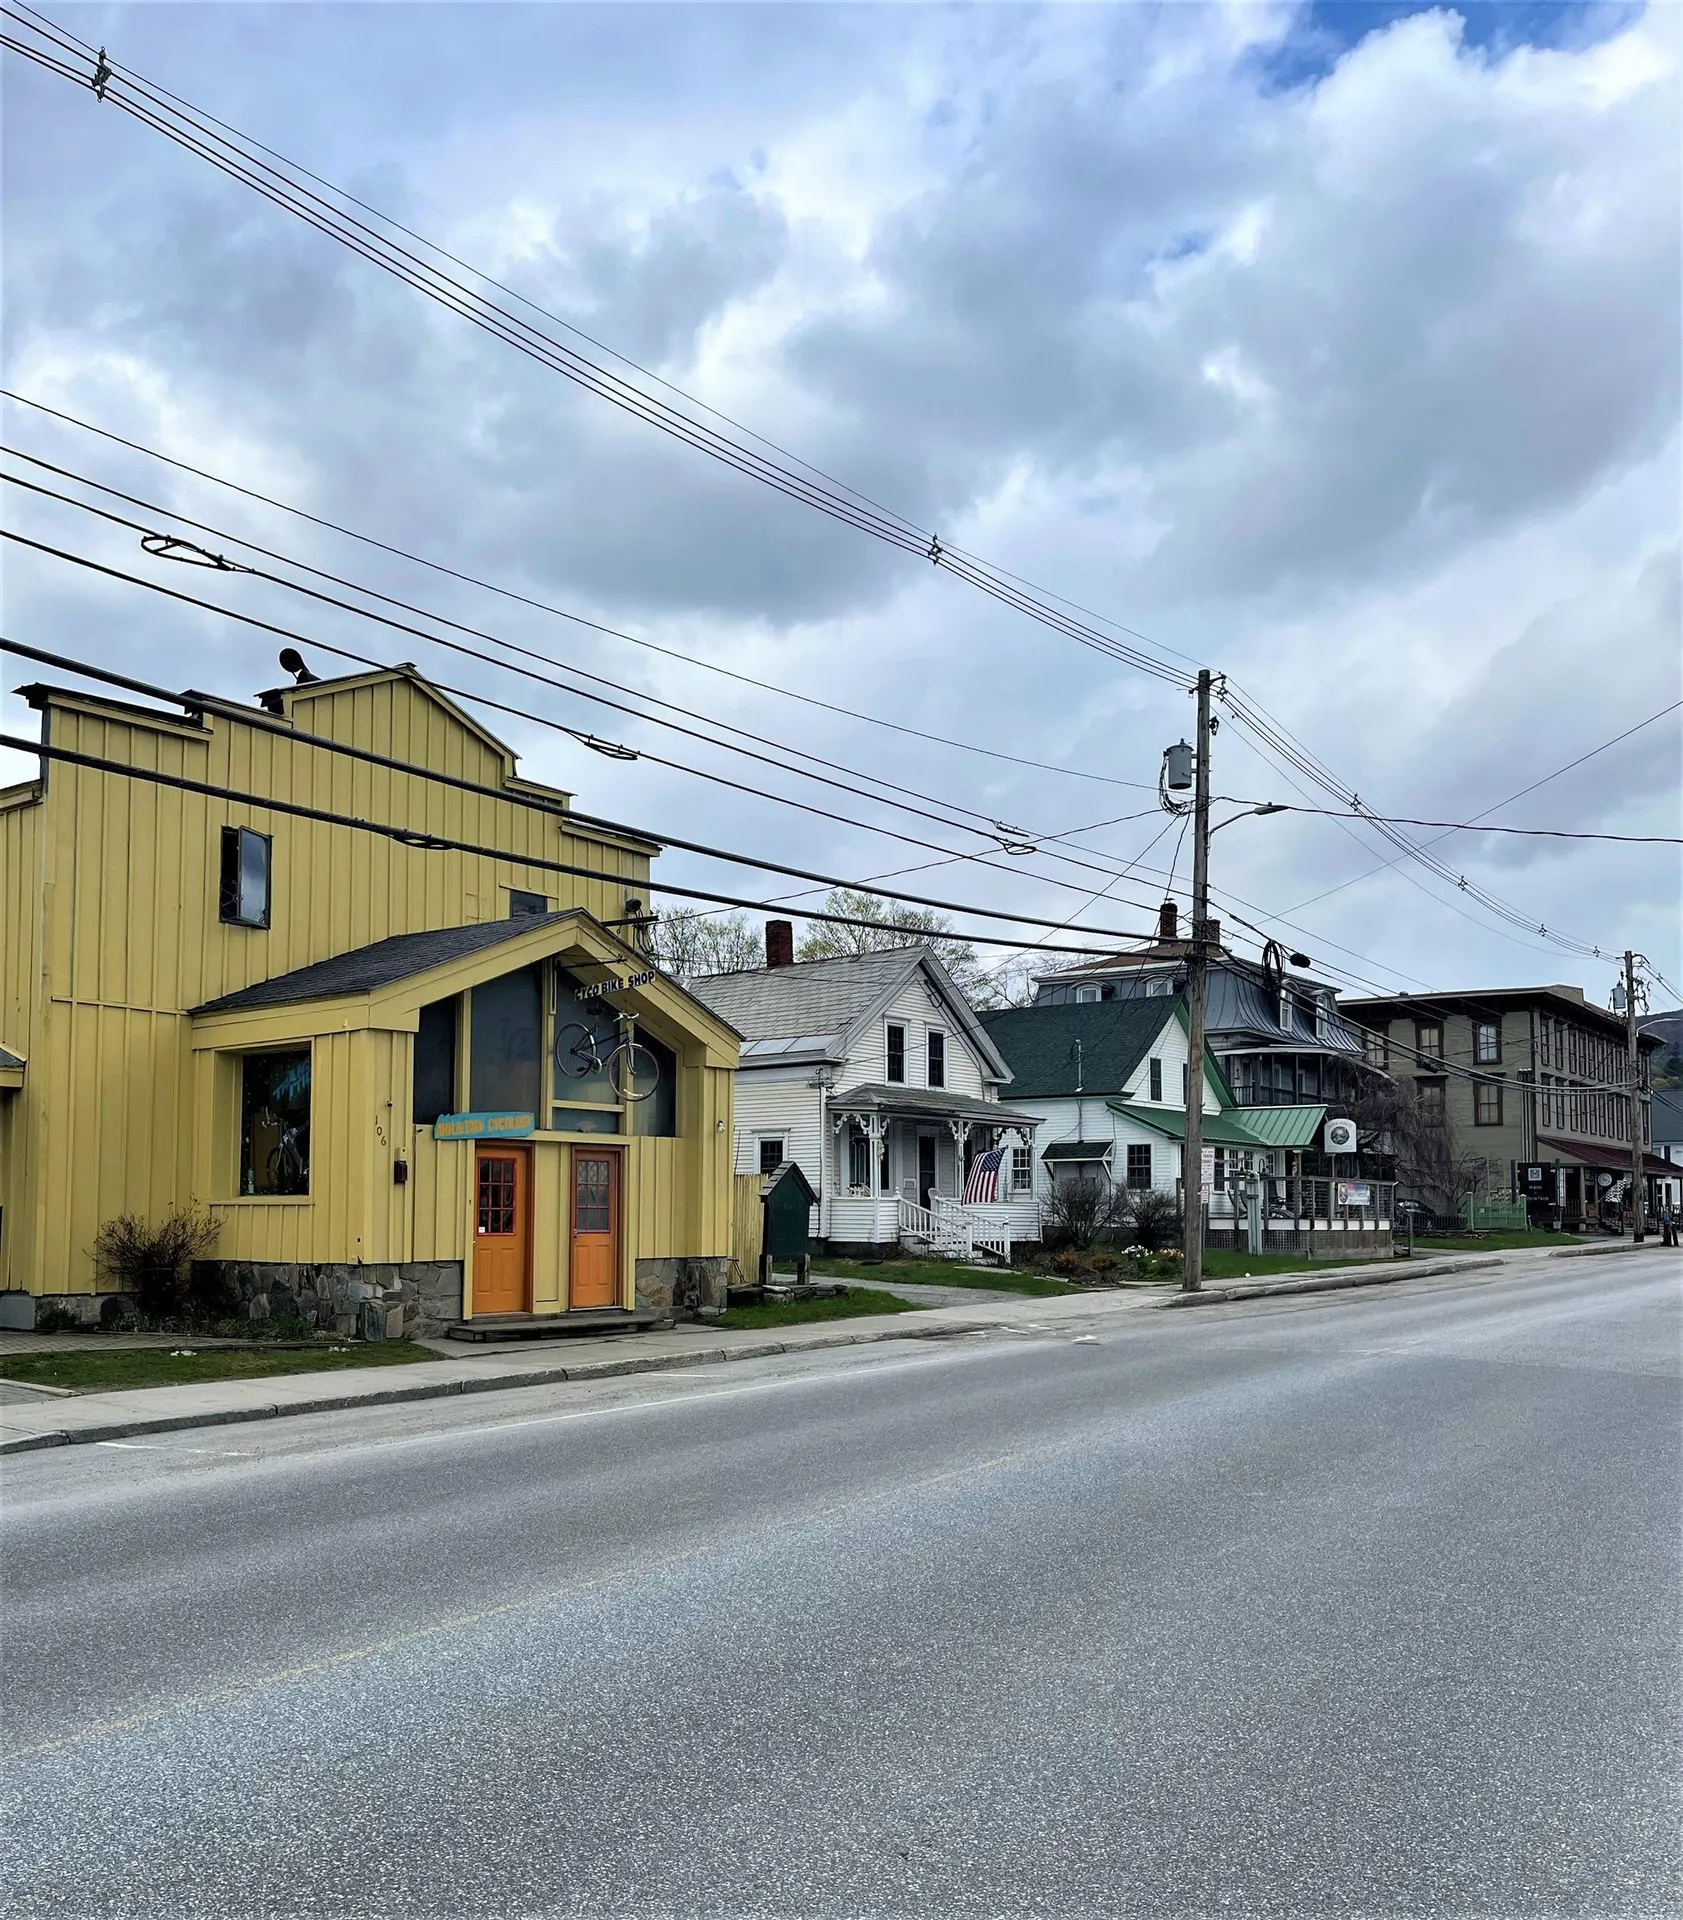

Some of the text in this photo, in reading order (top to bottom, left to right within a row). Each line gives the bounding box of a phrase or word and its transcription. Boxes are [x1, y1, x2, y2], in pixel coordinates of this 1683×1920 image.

[575, 970, 655, 1000] CYCO BIKE SHOP
[375, 1115, 386, 1146] 106
